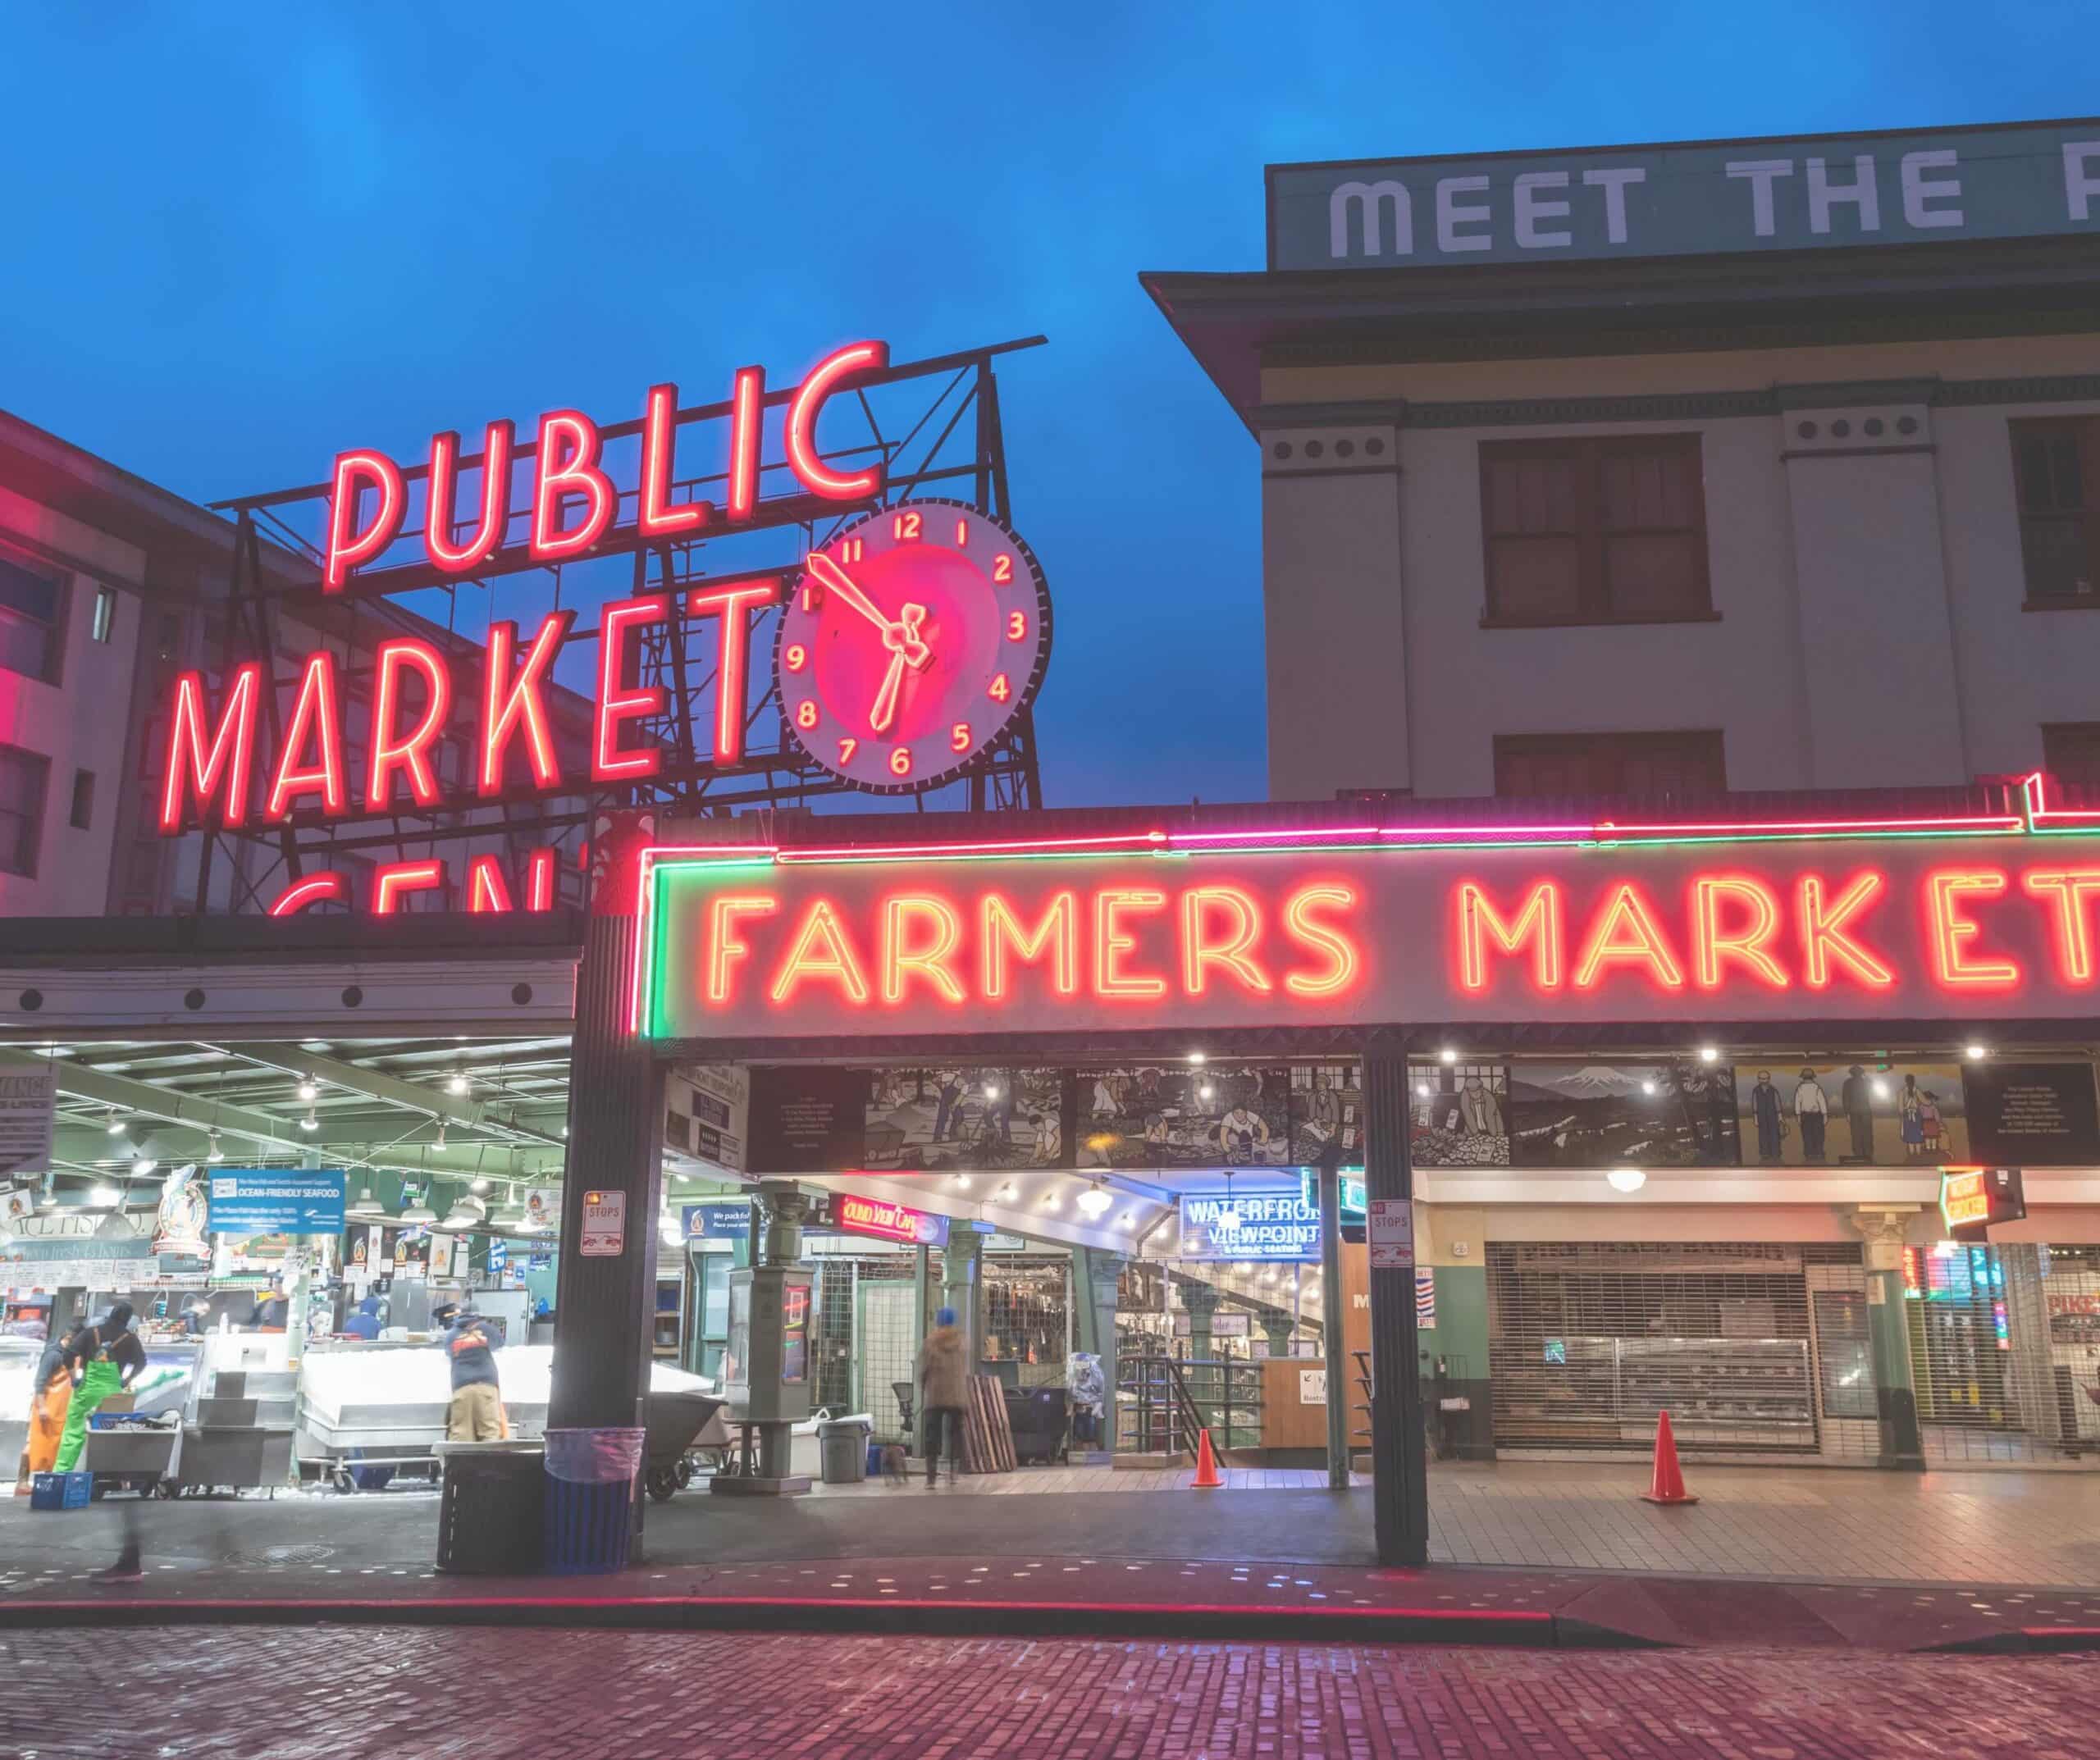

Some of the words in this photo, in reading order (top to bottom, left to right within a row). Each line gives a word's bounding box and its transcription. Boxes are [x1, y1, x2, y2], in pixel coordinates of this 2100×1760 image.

[1330, 167, 1646, 258] MEET
[1726, 149, 1965, 236] THE
[322, 340, 889, 594] PUBLIC
[894, 513, 920, 539] 12
[957, 520, 966, 545] 1
[842, 540, 861, 563] 11
[993, 555, 1011, 581] 2
[1007, 612, 1025, 639] 3
[787, 645, 805, 669] 9
[988, 674, 1007, 700] 4
[159, 576, 781, 835] MARKET
[797, 701, 816, 727] 8
[952, 724, 970, 750] 5
[839, 739, 856, 764] 7
[891, 748, 910, 774] 6
[708, 887, 1354, 1001] FARMERS
[1461, 873, 2100, 988] MARKET
[590, 1207, 619, 1218] STOPS
[1375, 1216, 1408, 1228] STOPS
[1208, 1225, 1320, 1244] VIEWPOINT
